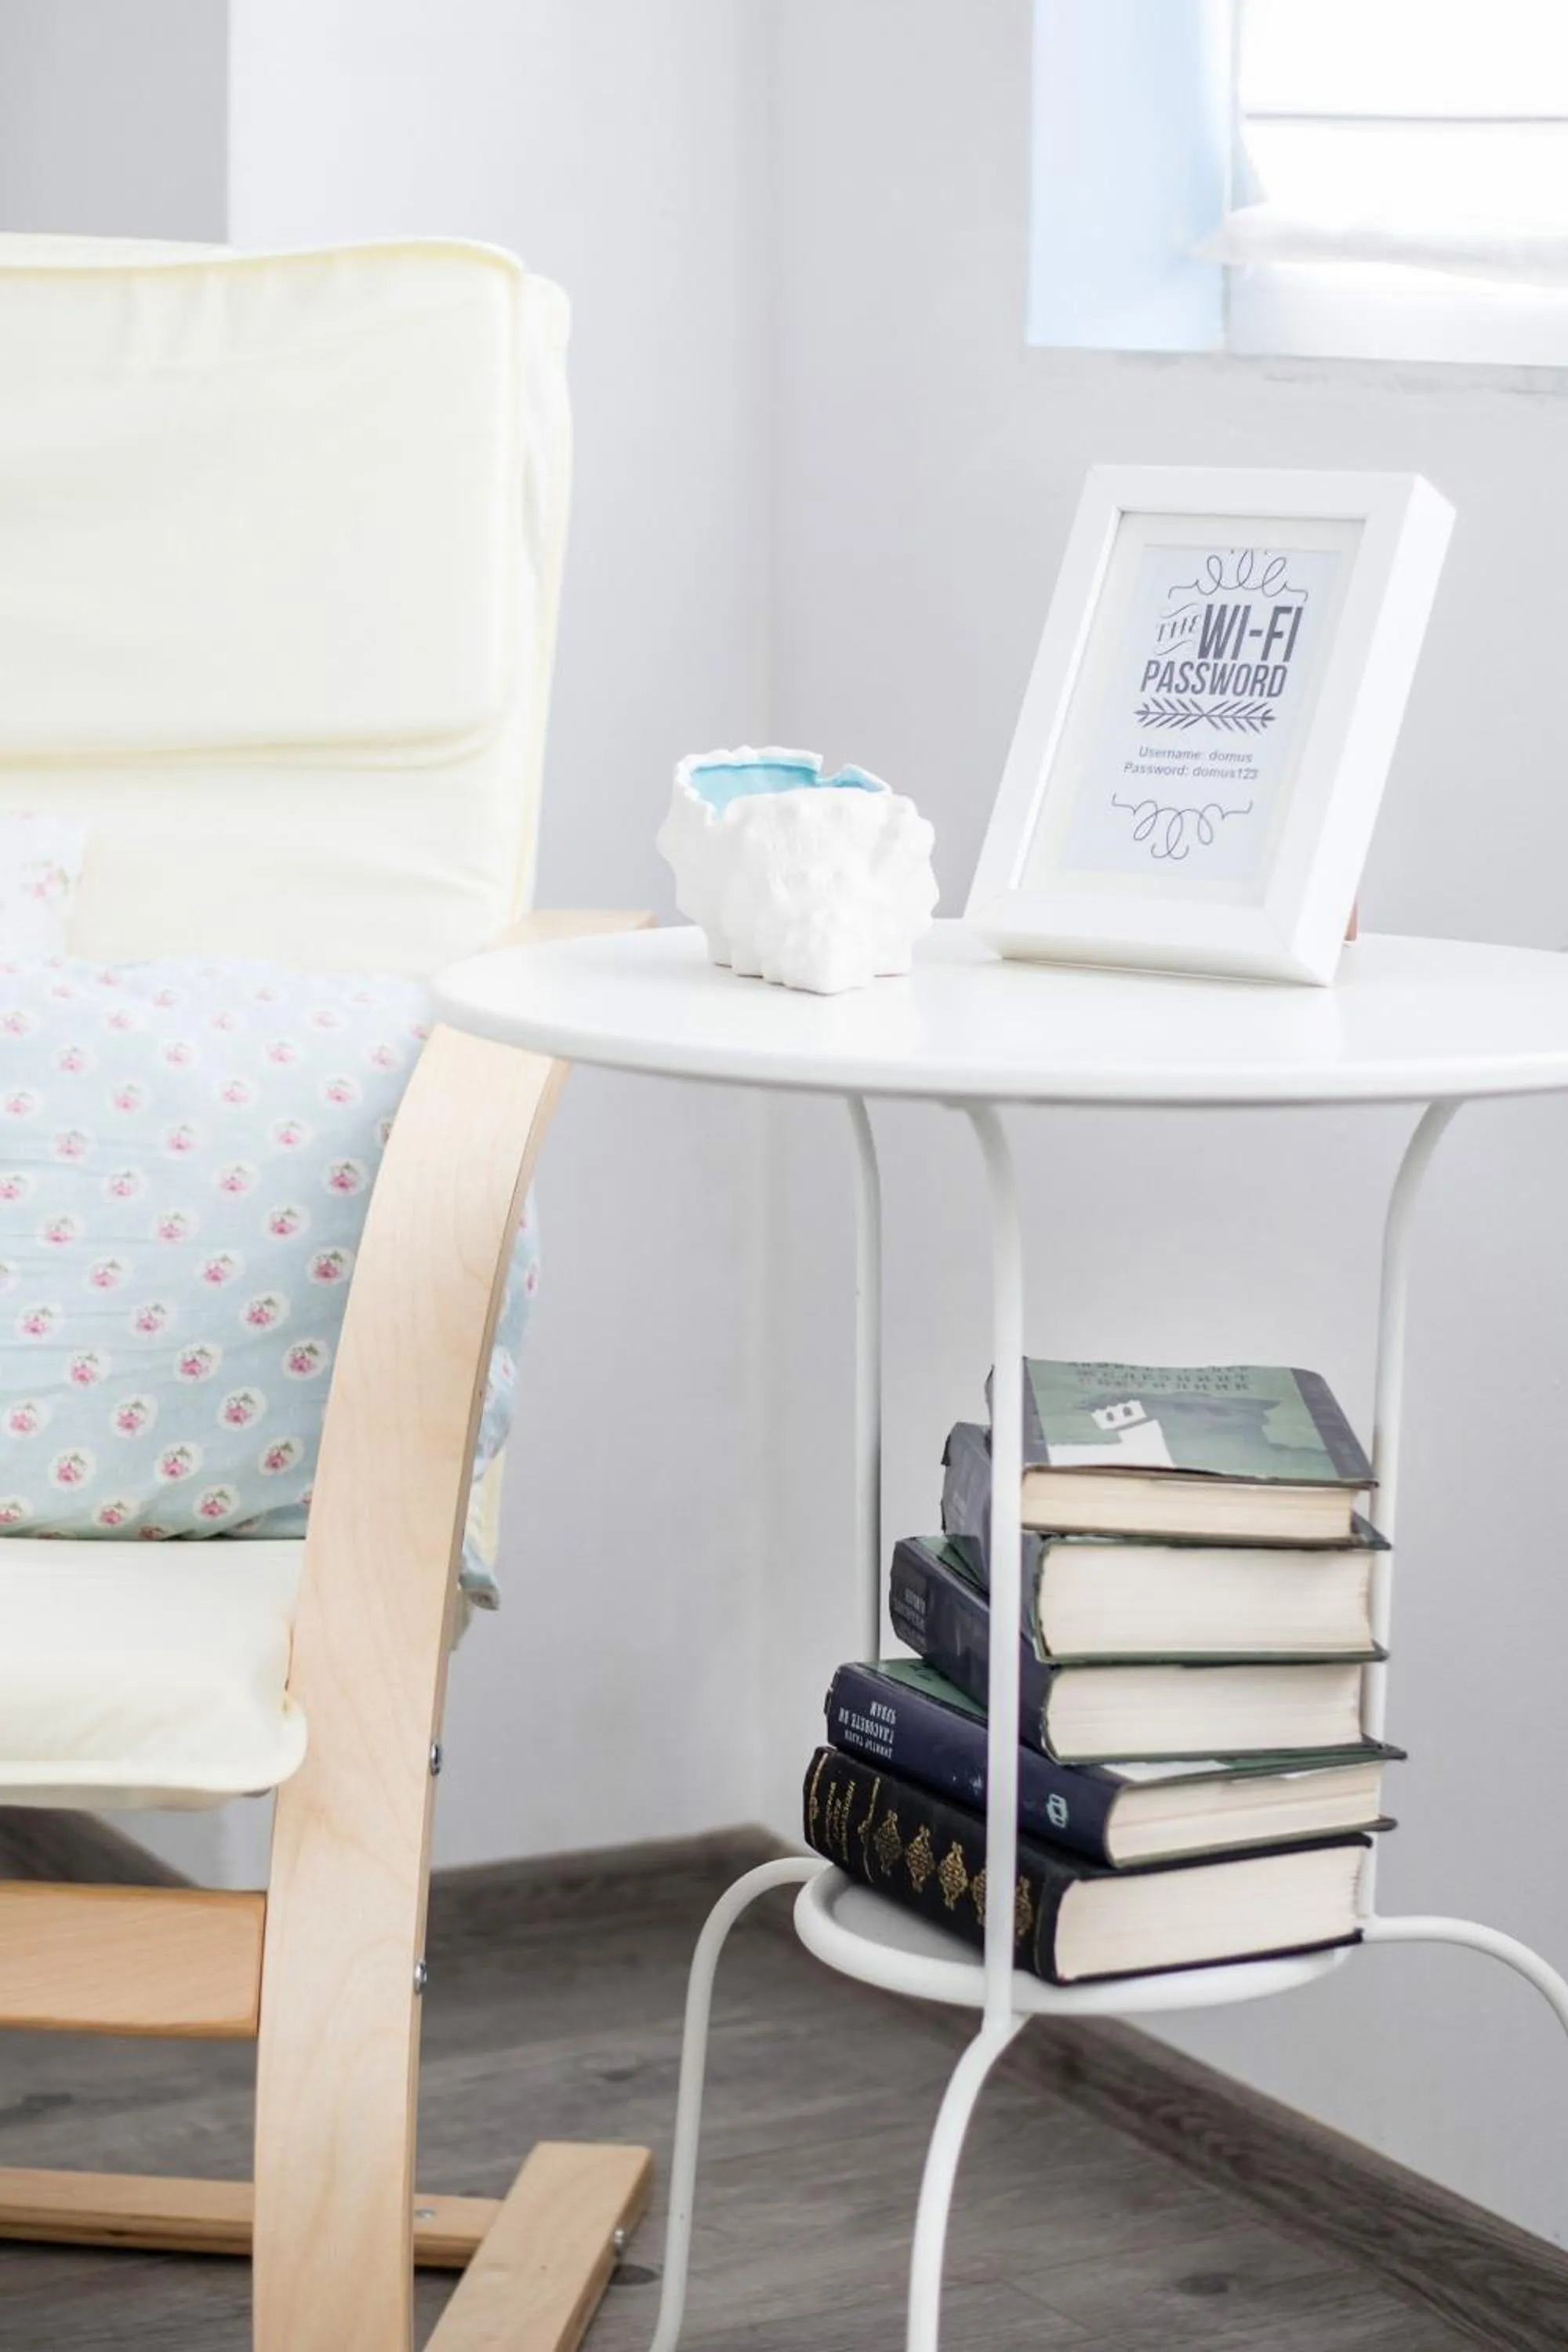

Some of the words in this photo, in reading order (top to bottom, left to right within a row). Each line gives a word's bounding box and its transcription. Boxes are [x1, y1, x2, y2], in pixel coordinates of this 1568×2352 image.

[1198, 603, 1304, 662] WI-FI
[1140, 659, 1288, 698] PASSWORD
[1138, 746, 1204, 760] Username:
[1208, 750, 1254, 763] domus
[1123, 761, 1189, 776] Password:
[1192, 765, 1260, 780] domus123
